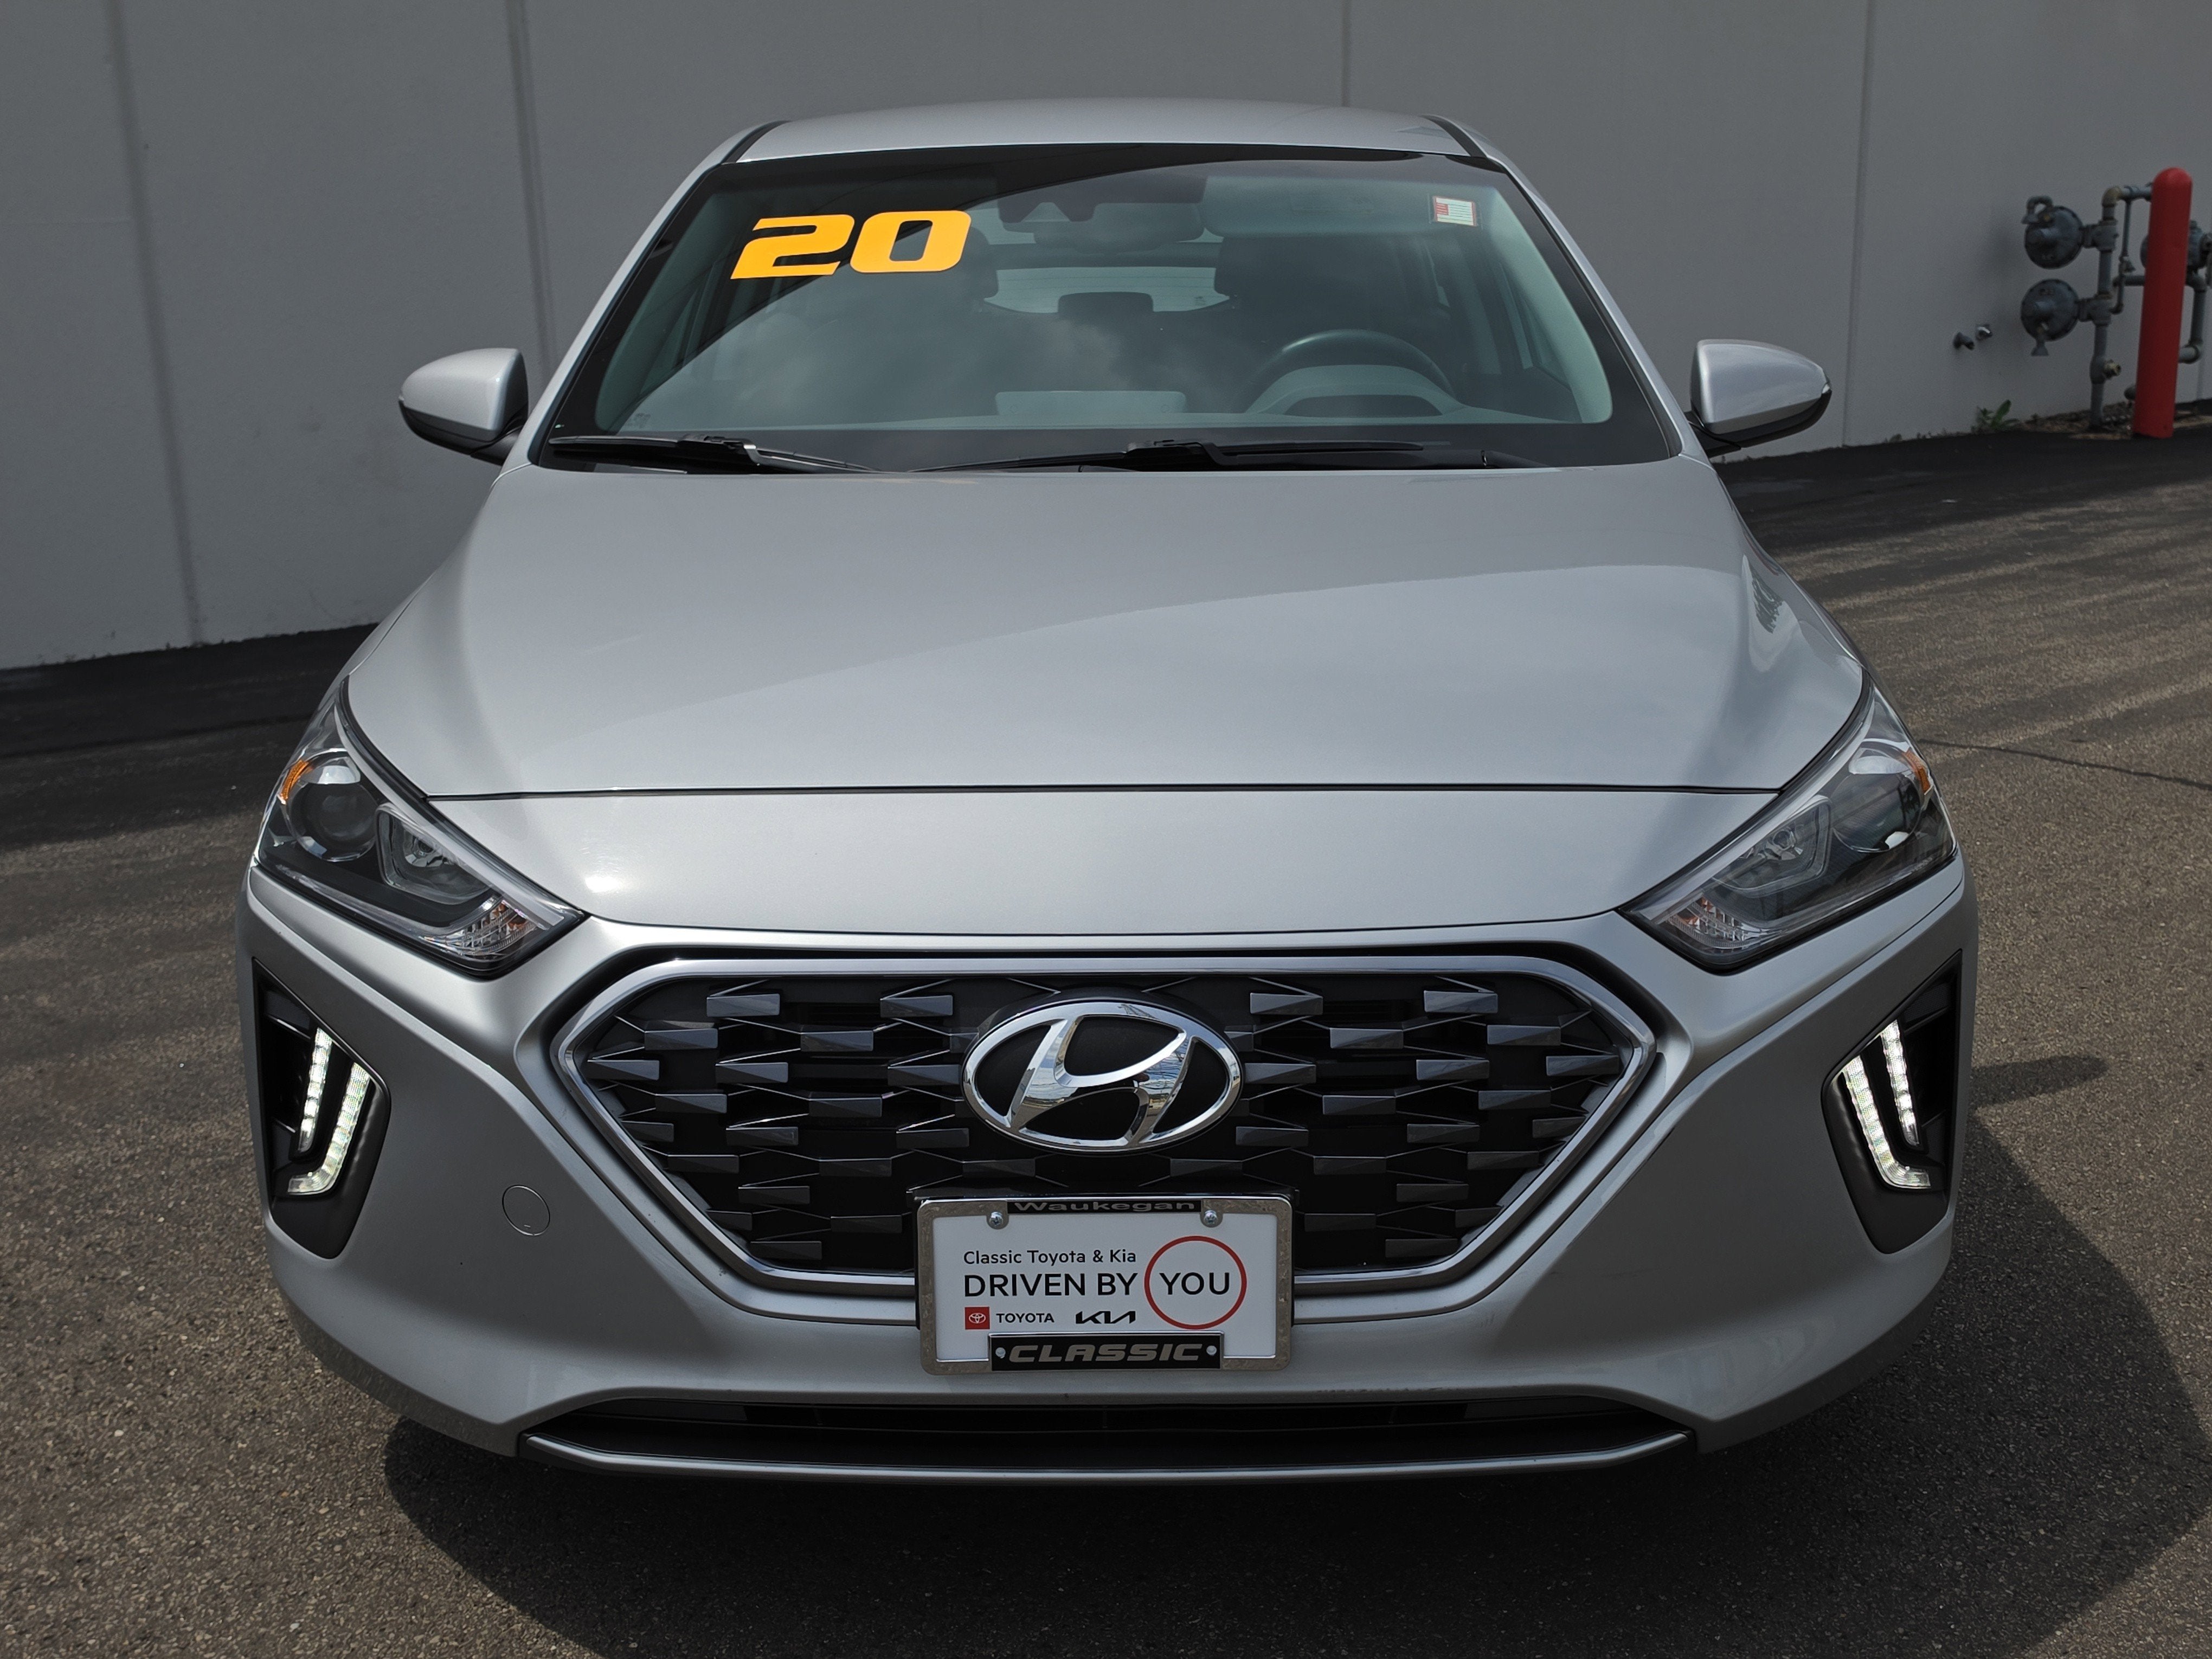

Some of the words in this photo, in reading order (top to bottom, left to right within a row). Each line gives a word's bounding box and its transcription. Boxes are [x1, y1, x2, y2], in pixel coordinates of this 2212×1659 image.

[730, 210, 971, 279] 20
[1014, 1201, 1195, 1211] Waukegan
[964, 1250, 1021, 1264] Classic
[1027, 1250, 1085, 1266] Toyota
[1093, 1250, 1103, 1262] &
[1110, 1249, 1136, 1262] Kia
[964, 1274, 1085, 1297] DRIVEN
[1098, 1273, 1138, 1295] BY
[1160, 1272, 1230, 1295] YOU
[996, 1313, 1054, 1323] TOYOTA
[1009, 1344, 1203, 1362] CLASSIC
